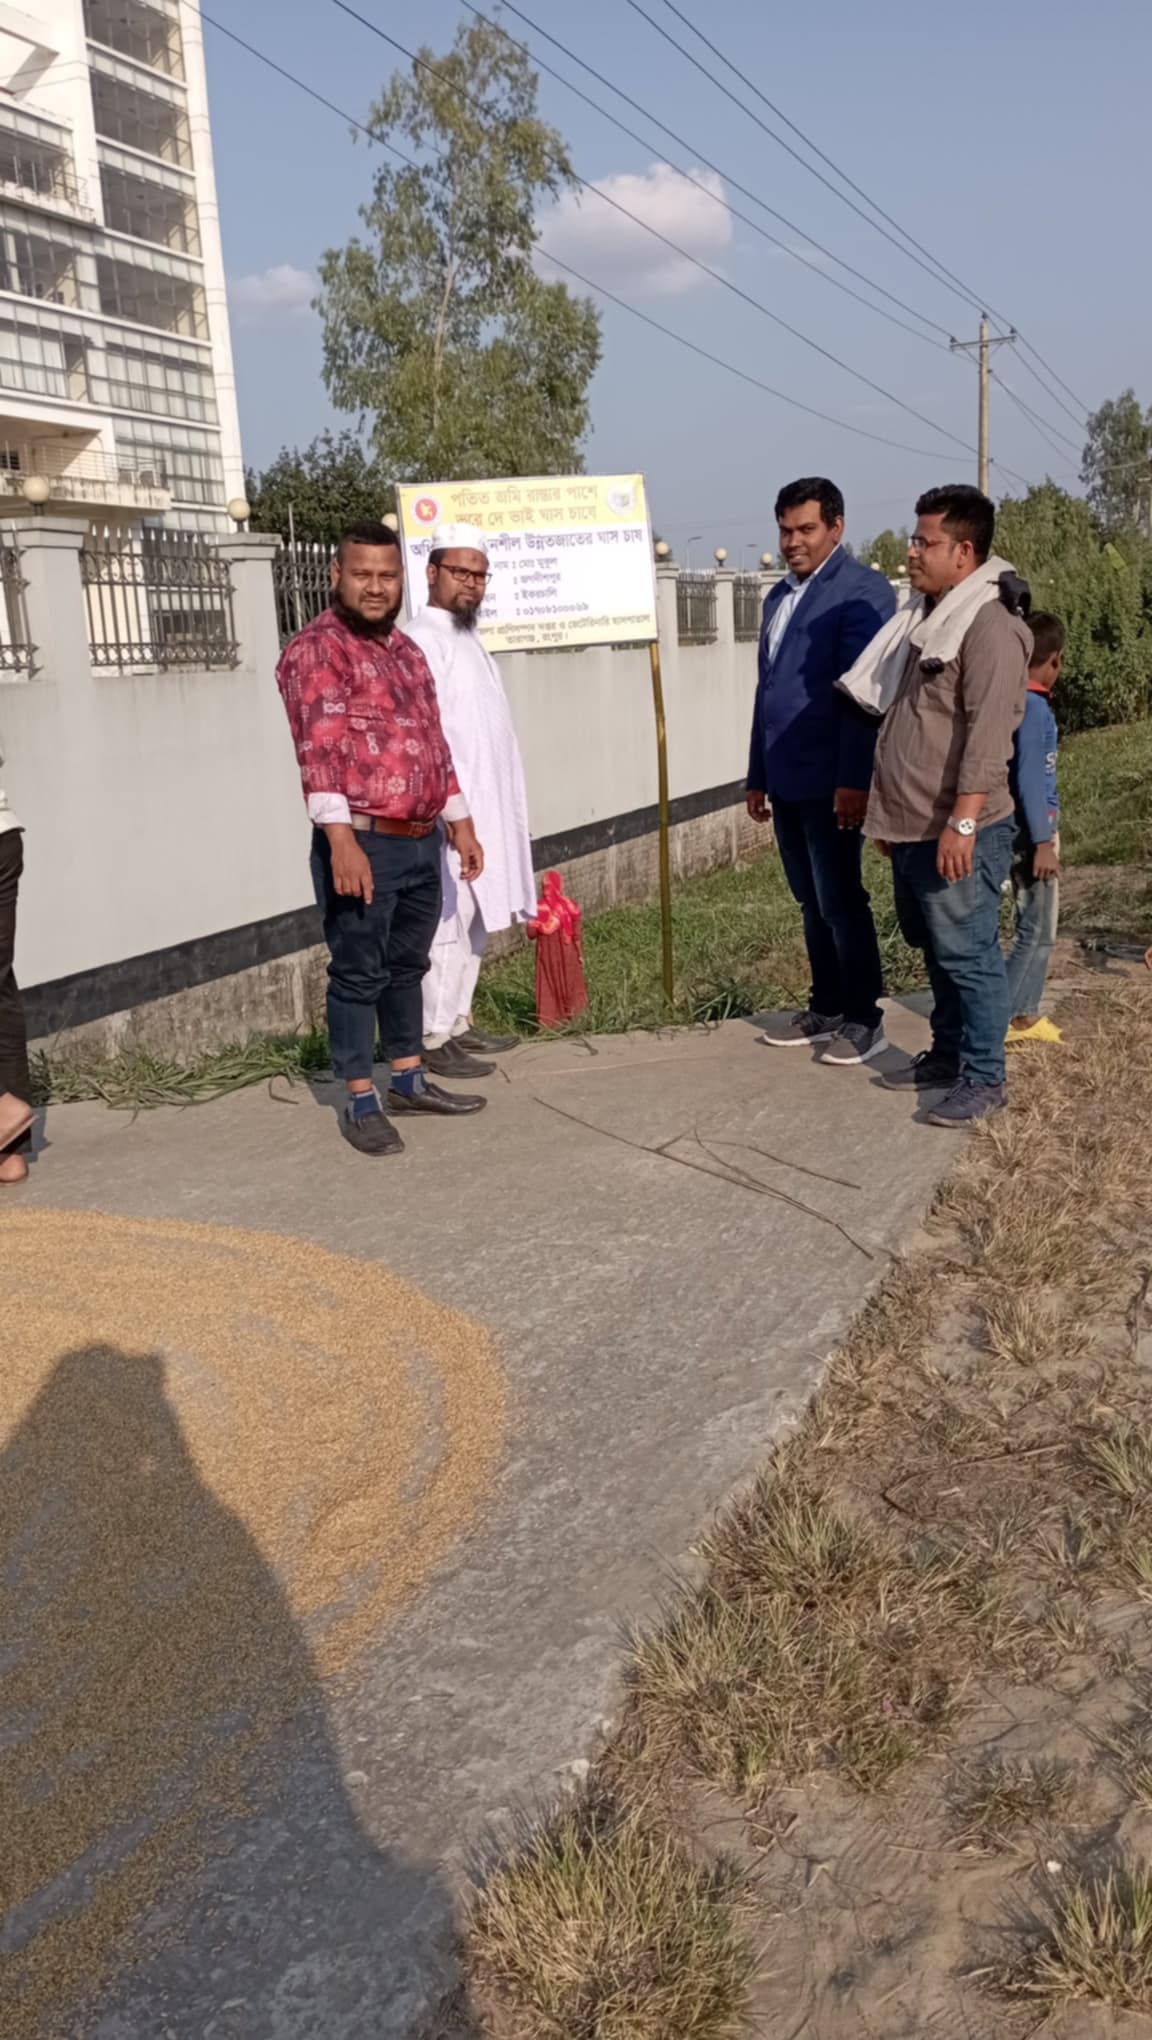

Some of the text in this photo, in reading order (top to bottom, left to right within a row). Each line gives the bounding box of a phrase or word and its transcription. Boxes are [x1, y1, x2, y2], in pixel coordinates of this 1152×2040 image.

[450, 488, 490, 506] পতিত
[494, 485, 521, 504] জমি
[566, 485, 598, 501] পাশে
[508, 506, 535, 524] ভাই
[538, 508, 563, 521] ঘাস
[567, 506, 597, 520] চাষে
[597, 529, 619, 545] ঘাস
[622, 528, 643, 543] চাষ
